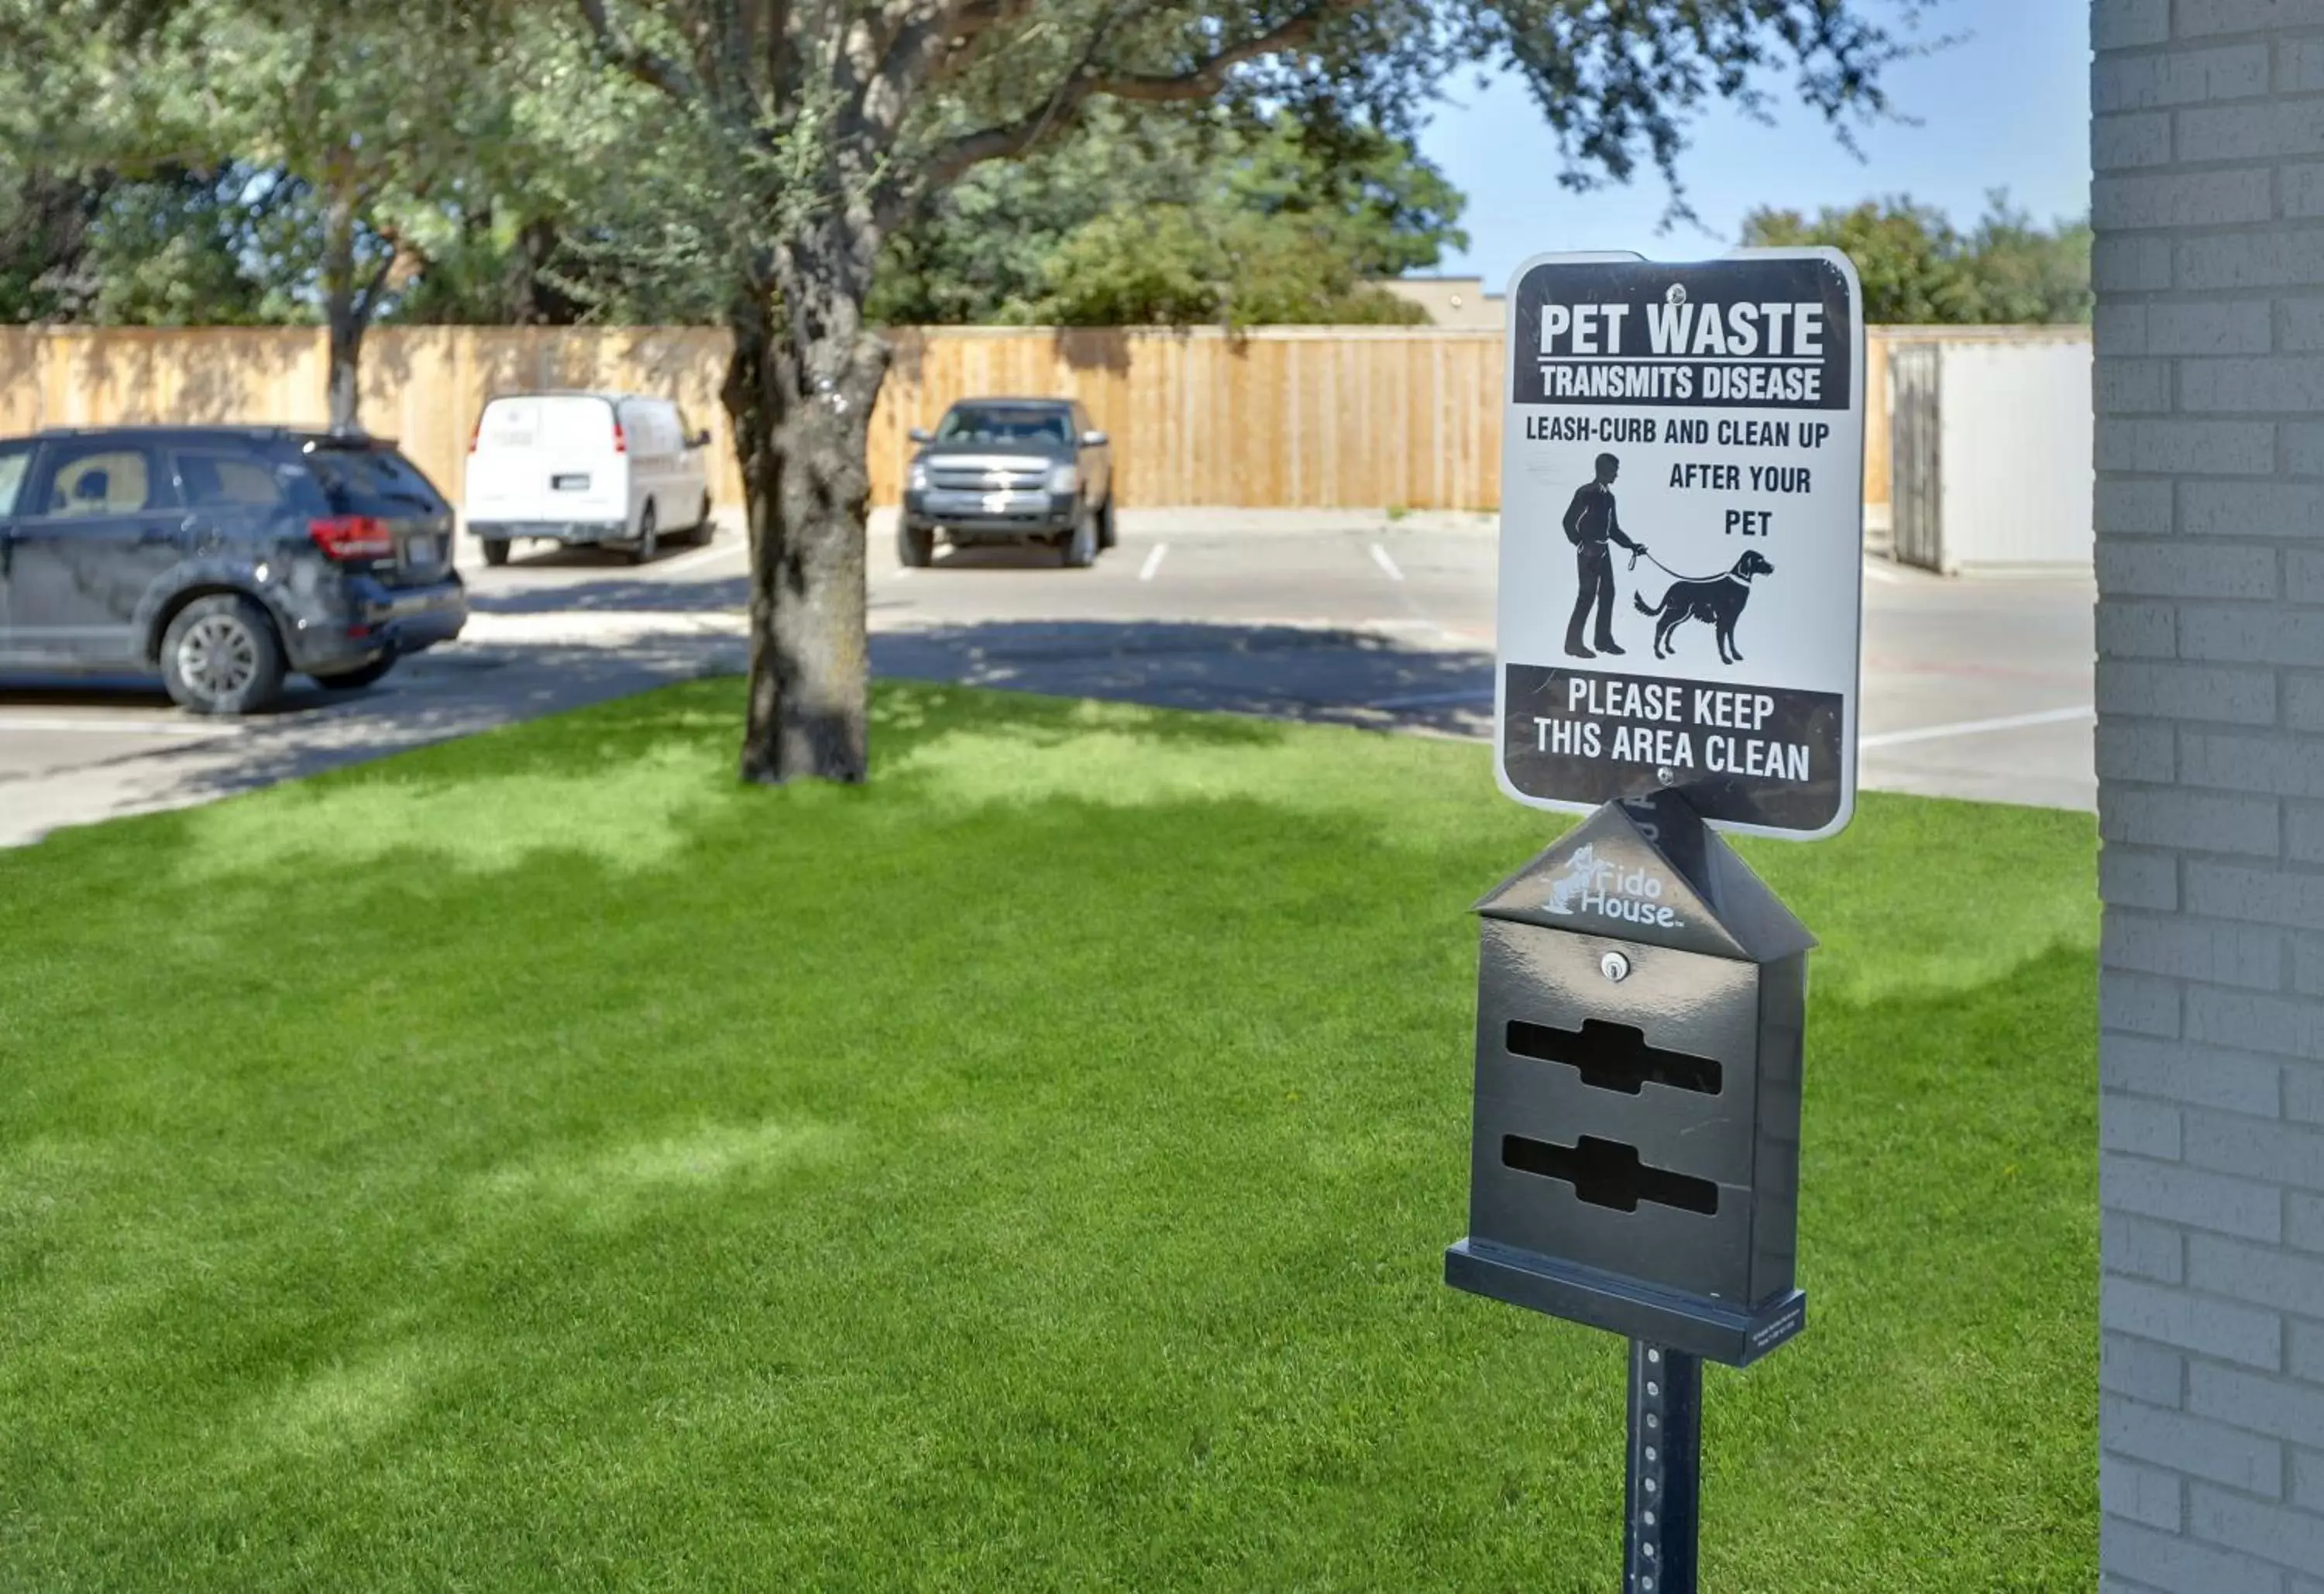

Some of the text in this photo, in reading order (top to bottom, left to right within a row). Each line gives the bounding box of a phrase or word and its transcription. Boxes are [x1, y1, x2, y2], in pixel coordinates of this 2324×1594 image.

[1539, 302, 1824, 356] PET WASTE
[1539, 365, 1821, 401] TRANSMITS DISEASE
[1526, 416, 1830, 448] LEASH-CURB AND CLEAN UP
[1669, 463, 1811, 493] AFTER YOUR
[1725, 510, 1773, 537] PET
[1569, 677, 1775, 730] PLEASE KEEP
[1534, 716, 1810, 782] THIS AREA CLEAN
[1581, 888, 1674, 928] House
